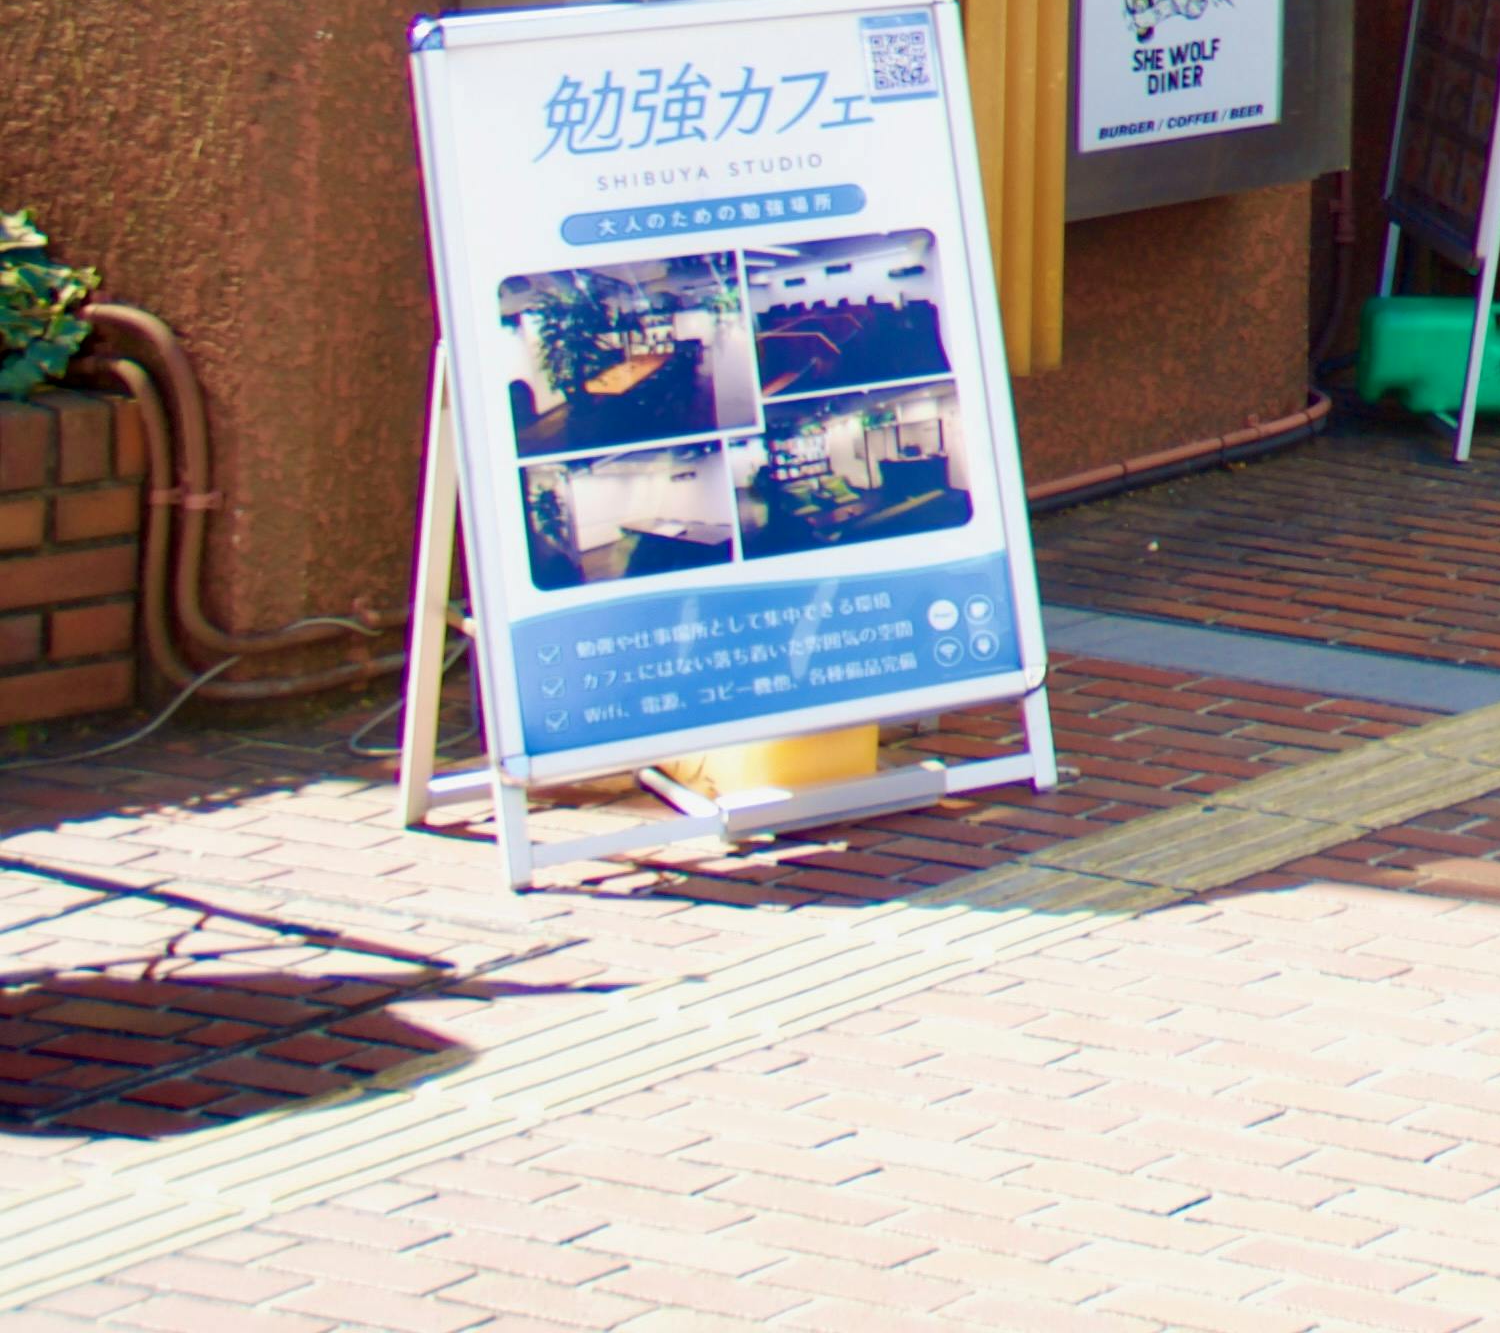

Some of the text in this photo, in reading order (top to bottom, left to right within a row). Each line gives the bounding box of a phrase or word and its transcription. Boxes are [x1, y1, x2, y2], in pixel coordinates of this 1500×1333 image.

[1132, 38, 1221, 72] SHE WOLF
[1147, 65, 1204, 95] DINER
[532, 61, 875, 164] 勉強カフェ
[1099, 120, 1155, 140] BURGER
[1167, 110, 1219, 129] COFFEE
[1229, 104, 1264, 120] BEER
[597, 152, 824, 192] SHIBUYA STUDIO
[598, 192, 833, 237] 大人のための勉強場所
